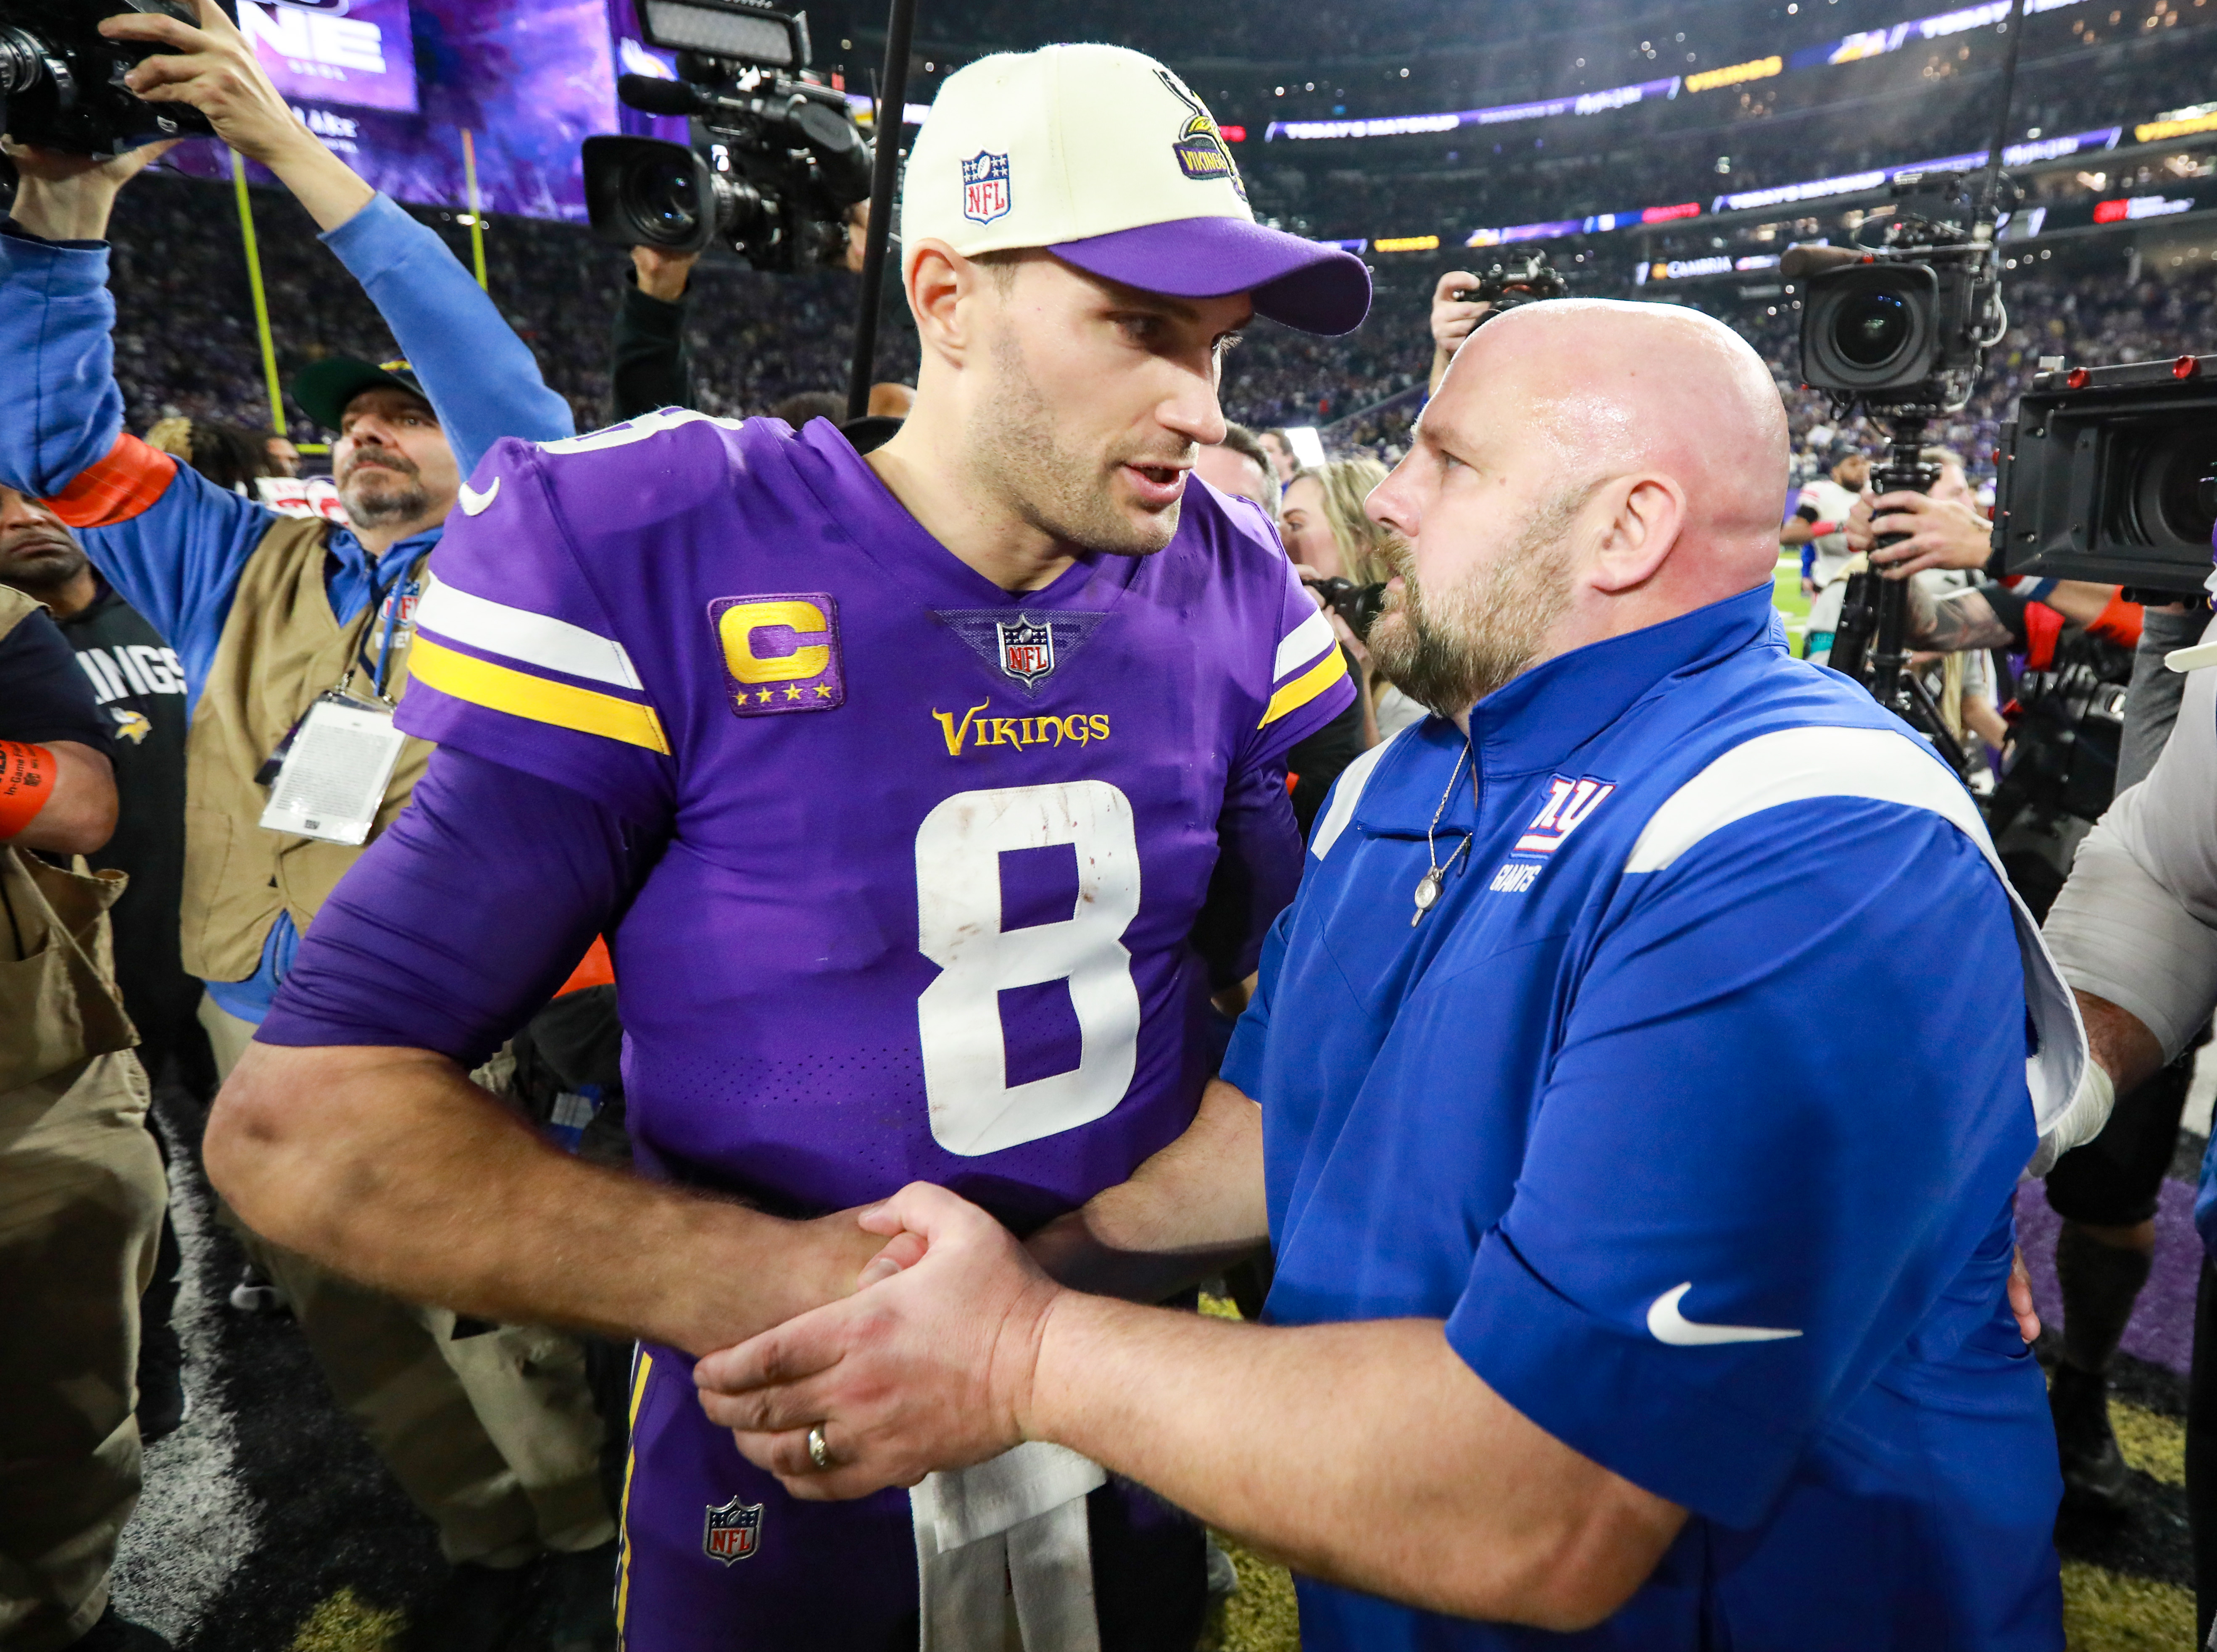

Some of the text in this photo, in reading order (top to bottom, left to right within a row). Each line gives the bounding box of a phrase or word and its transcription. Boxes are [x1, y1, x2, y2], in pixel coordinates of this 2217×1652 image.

[1180, 149, 1227, 171] VIKINGS
[968, 181, 1005, 215] NFL
[1667, 255, 1733, 279] CAMBRIA
[719, 601, 829, 684] C
[1009, 647, 1047, 672] NFL
[75, 645, 188, 705] INGS
[1490, 864, 1542, 892] GIANTS
[915, 780, 1140, 1156] 8
[711, 1529, 750, 1554] NFL
